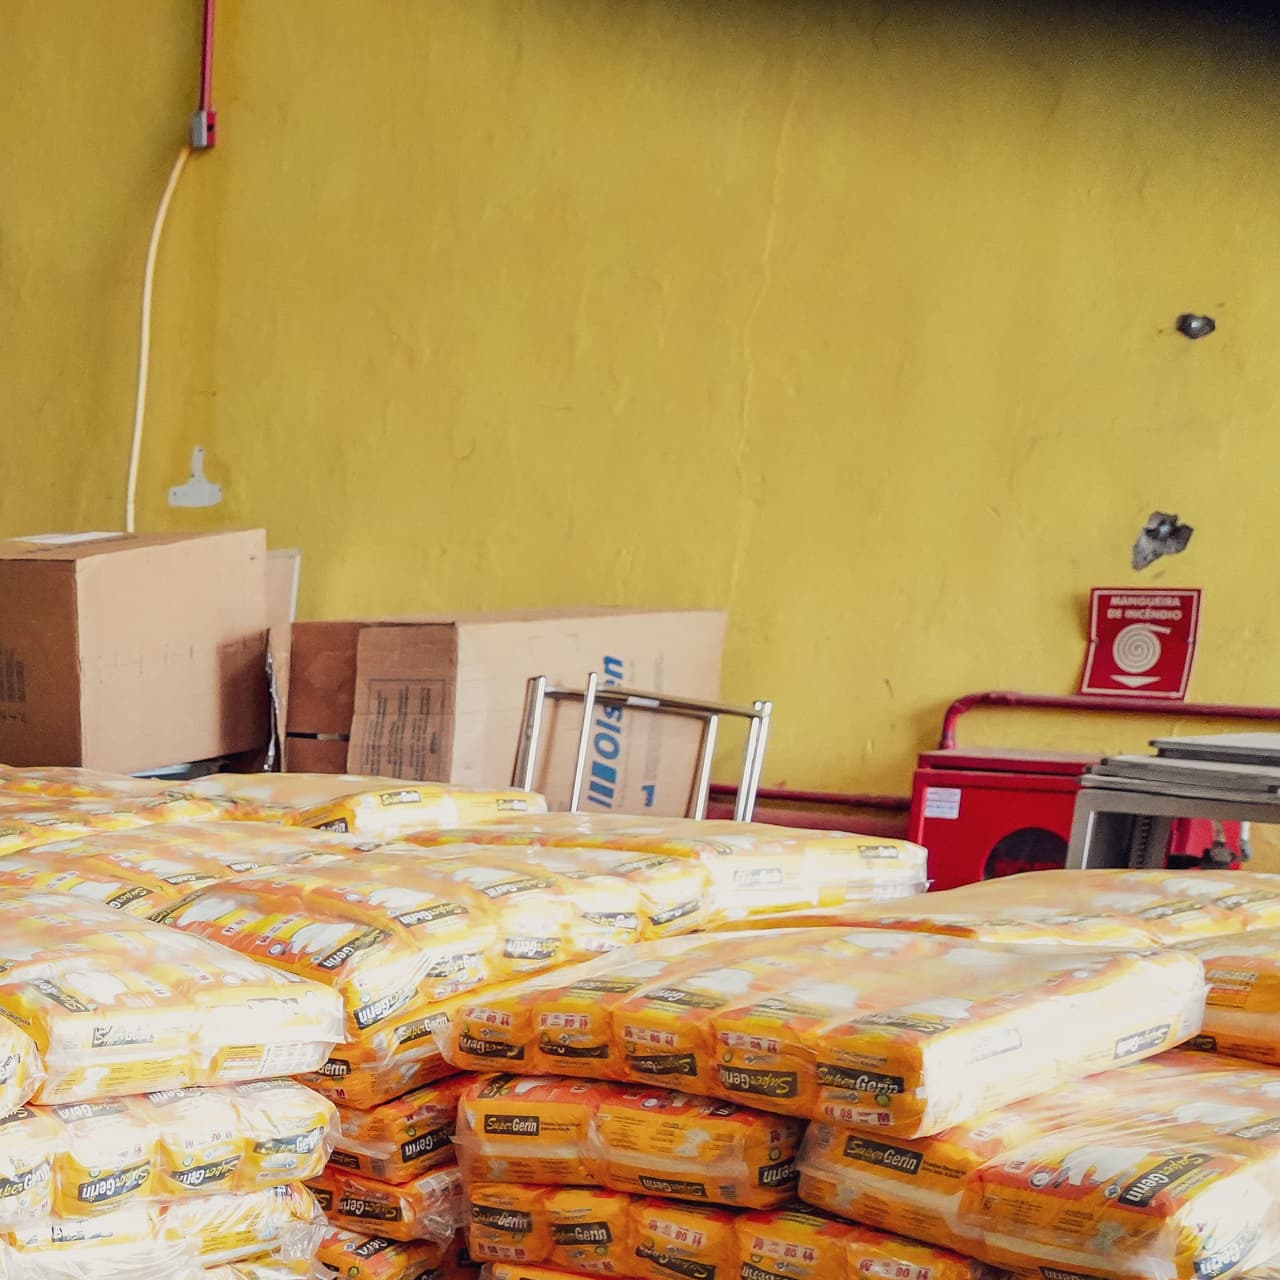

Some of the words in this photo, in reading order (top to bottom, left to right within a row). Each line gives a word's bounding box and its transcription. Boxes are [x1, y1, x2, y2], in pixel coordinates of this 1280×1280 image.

[1110, 595, 1181, 608] MANGUEIRA
[1107, 609, 1122, 620] DE
[641, 784, 656, 807] 1
